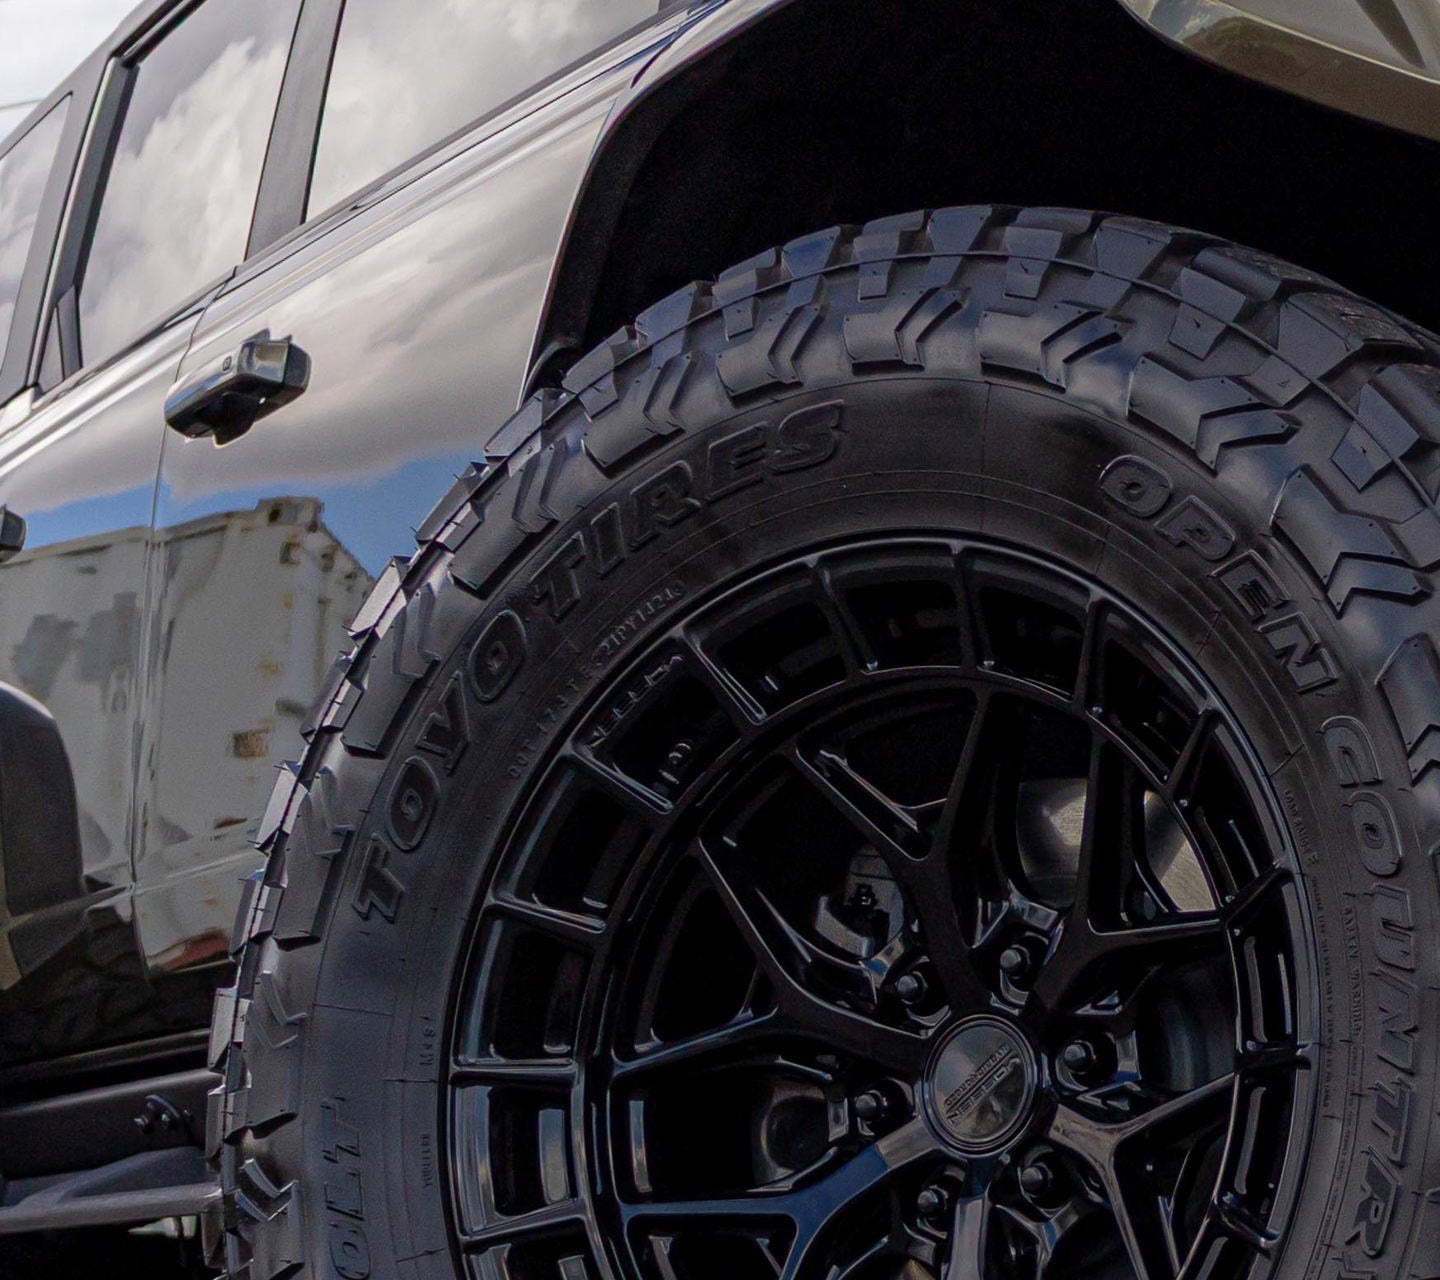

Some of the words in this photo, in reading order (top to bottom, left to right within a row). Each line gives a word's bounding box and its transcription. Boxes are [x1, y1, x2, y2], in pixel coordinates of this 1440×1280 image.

[356, 608, 530, 924] TOYO
[529, 399, 845, 617] TIRES
[1097, 453, 1336, 696] OPEN
